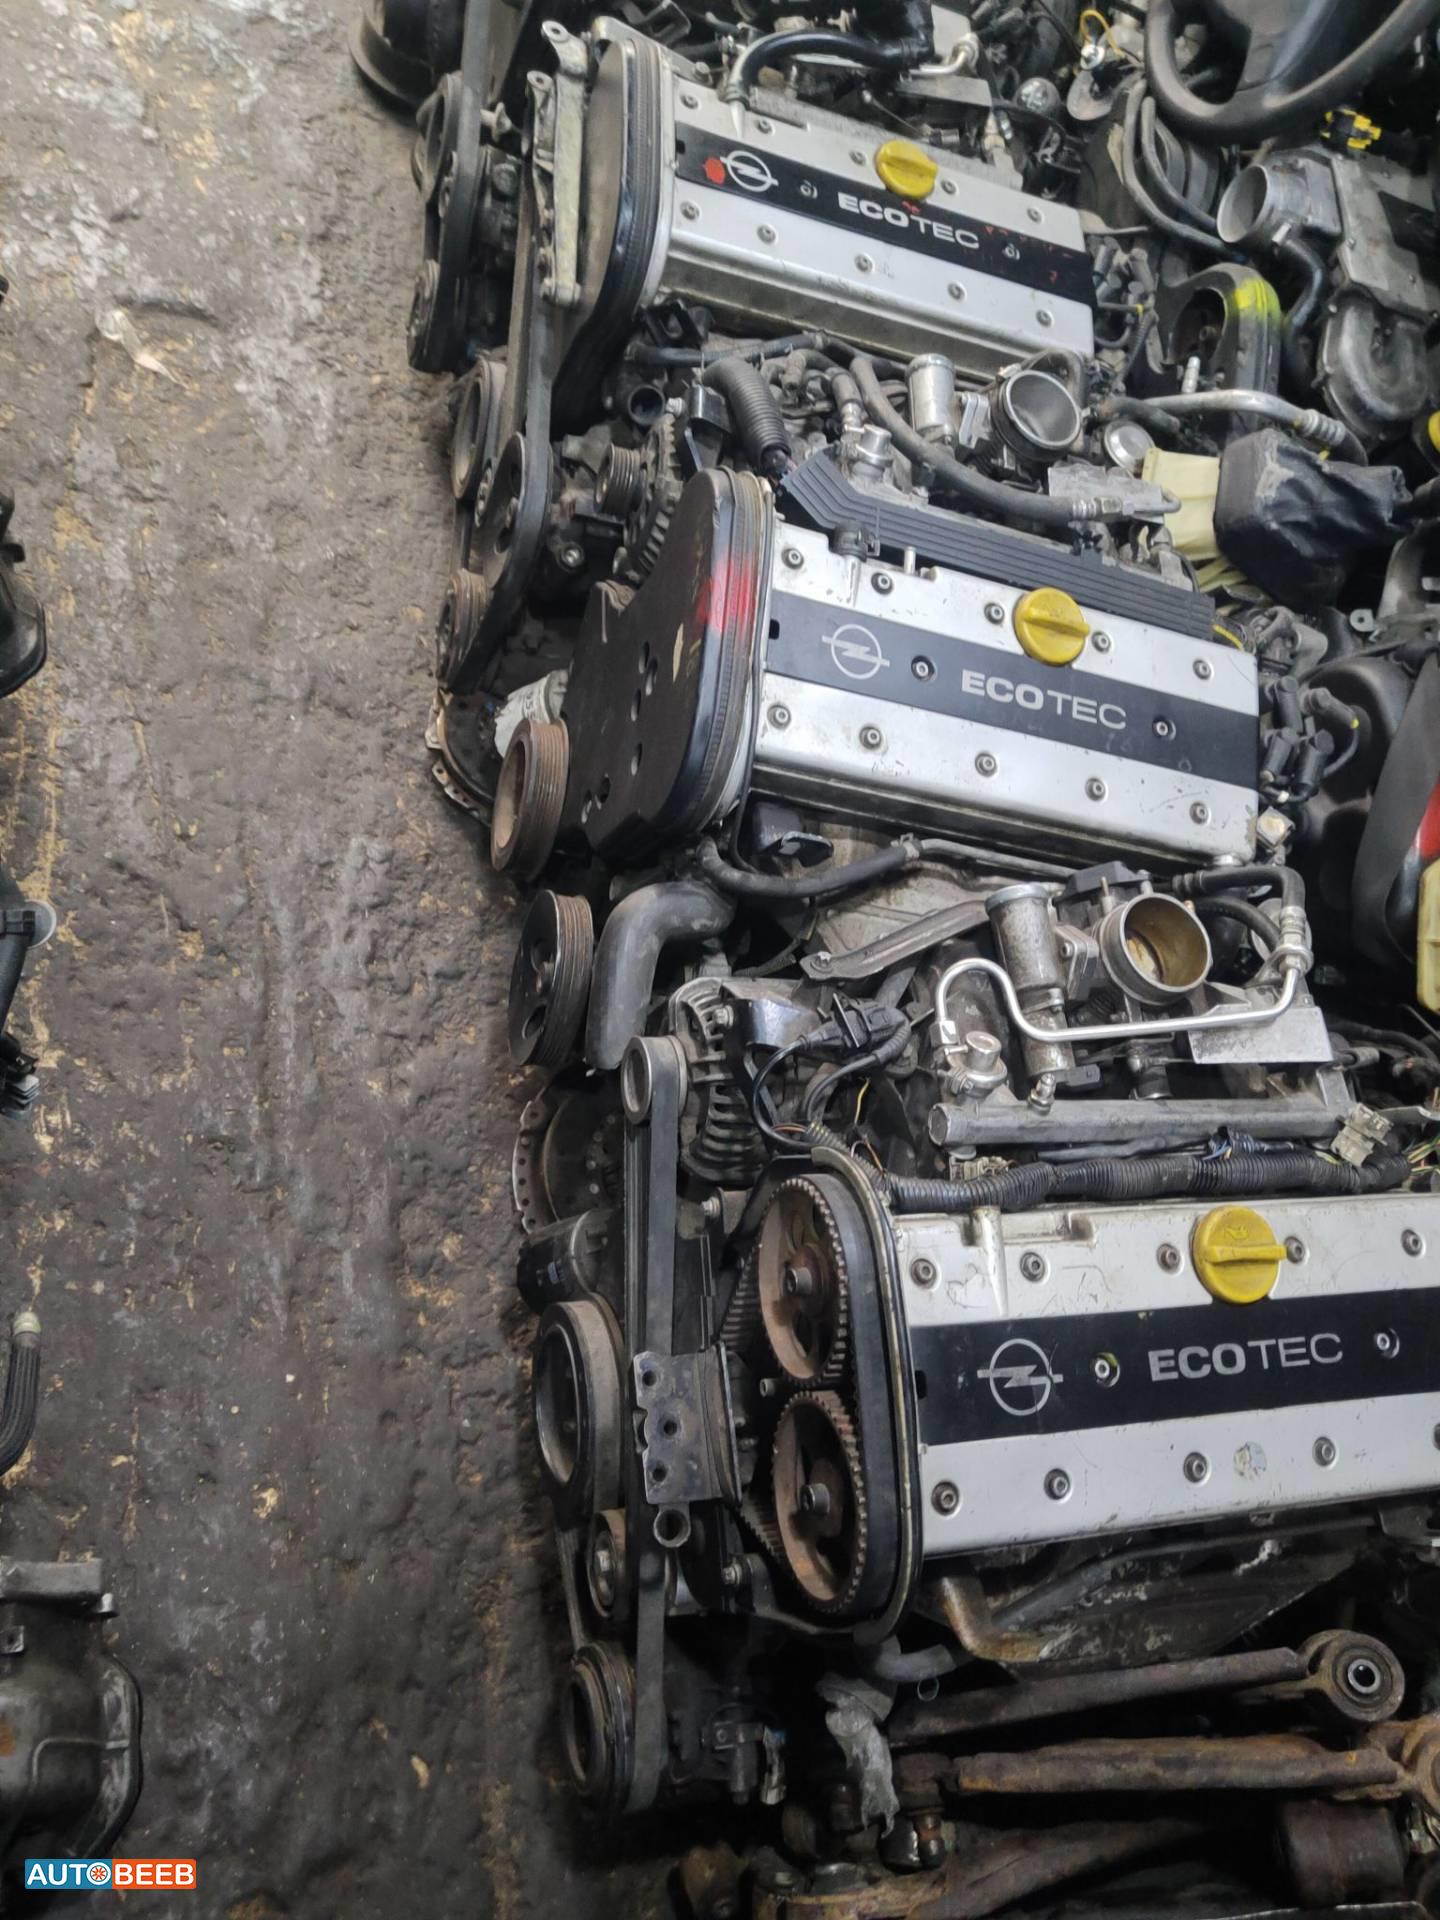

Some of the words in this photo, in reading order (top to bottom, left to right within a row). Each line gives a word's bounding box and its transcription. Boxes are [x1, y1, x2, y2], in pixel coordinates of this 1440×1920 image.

[837, 191, 980, 249] ECOTEC
[961, 668, 1127, 730] ECOTEC
[1147, 1332, 1344, 1382] ECOTEC
